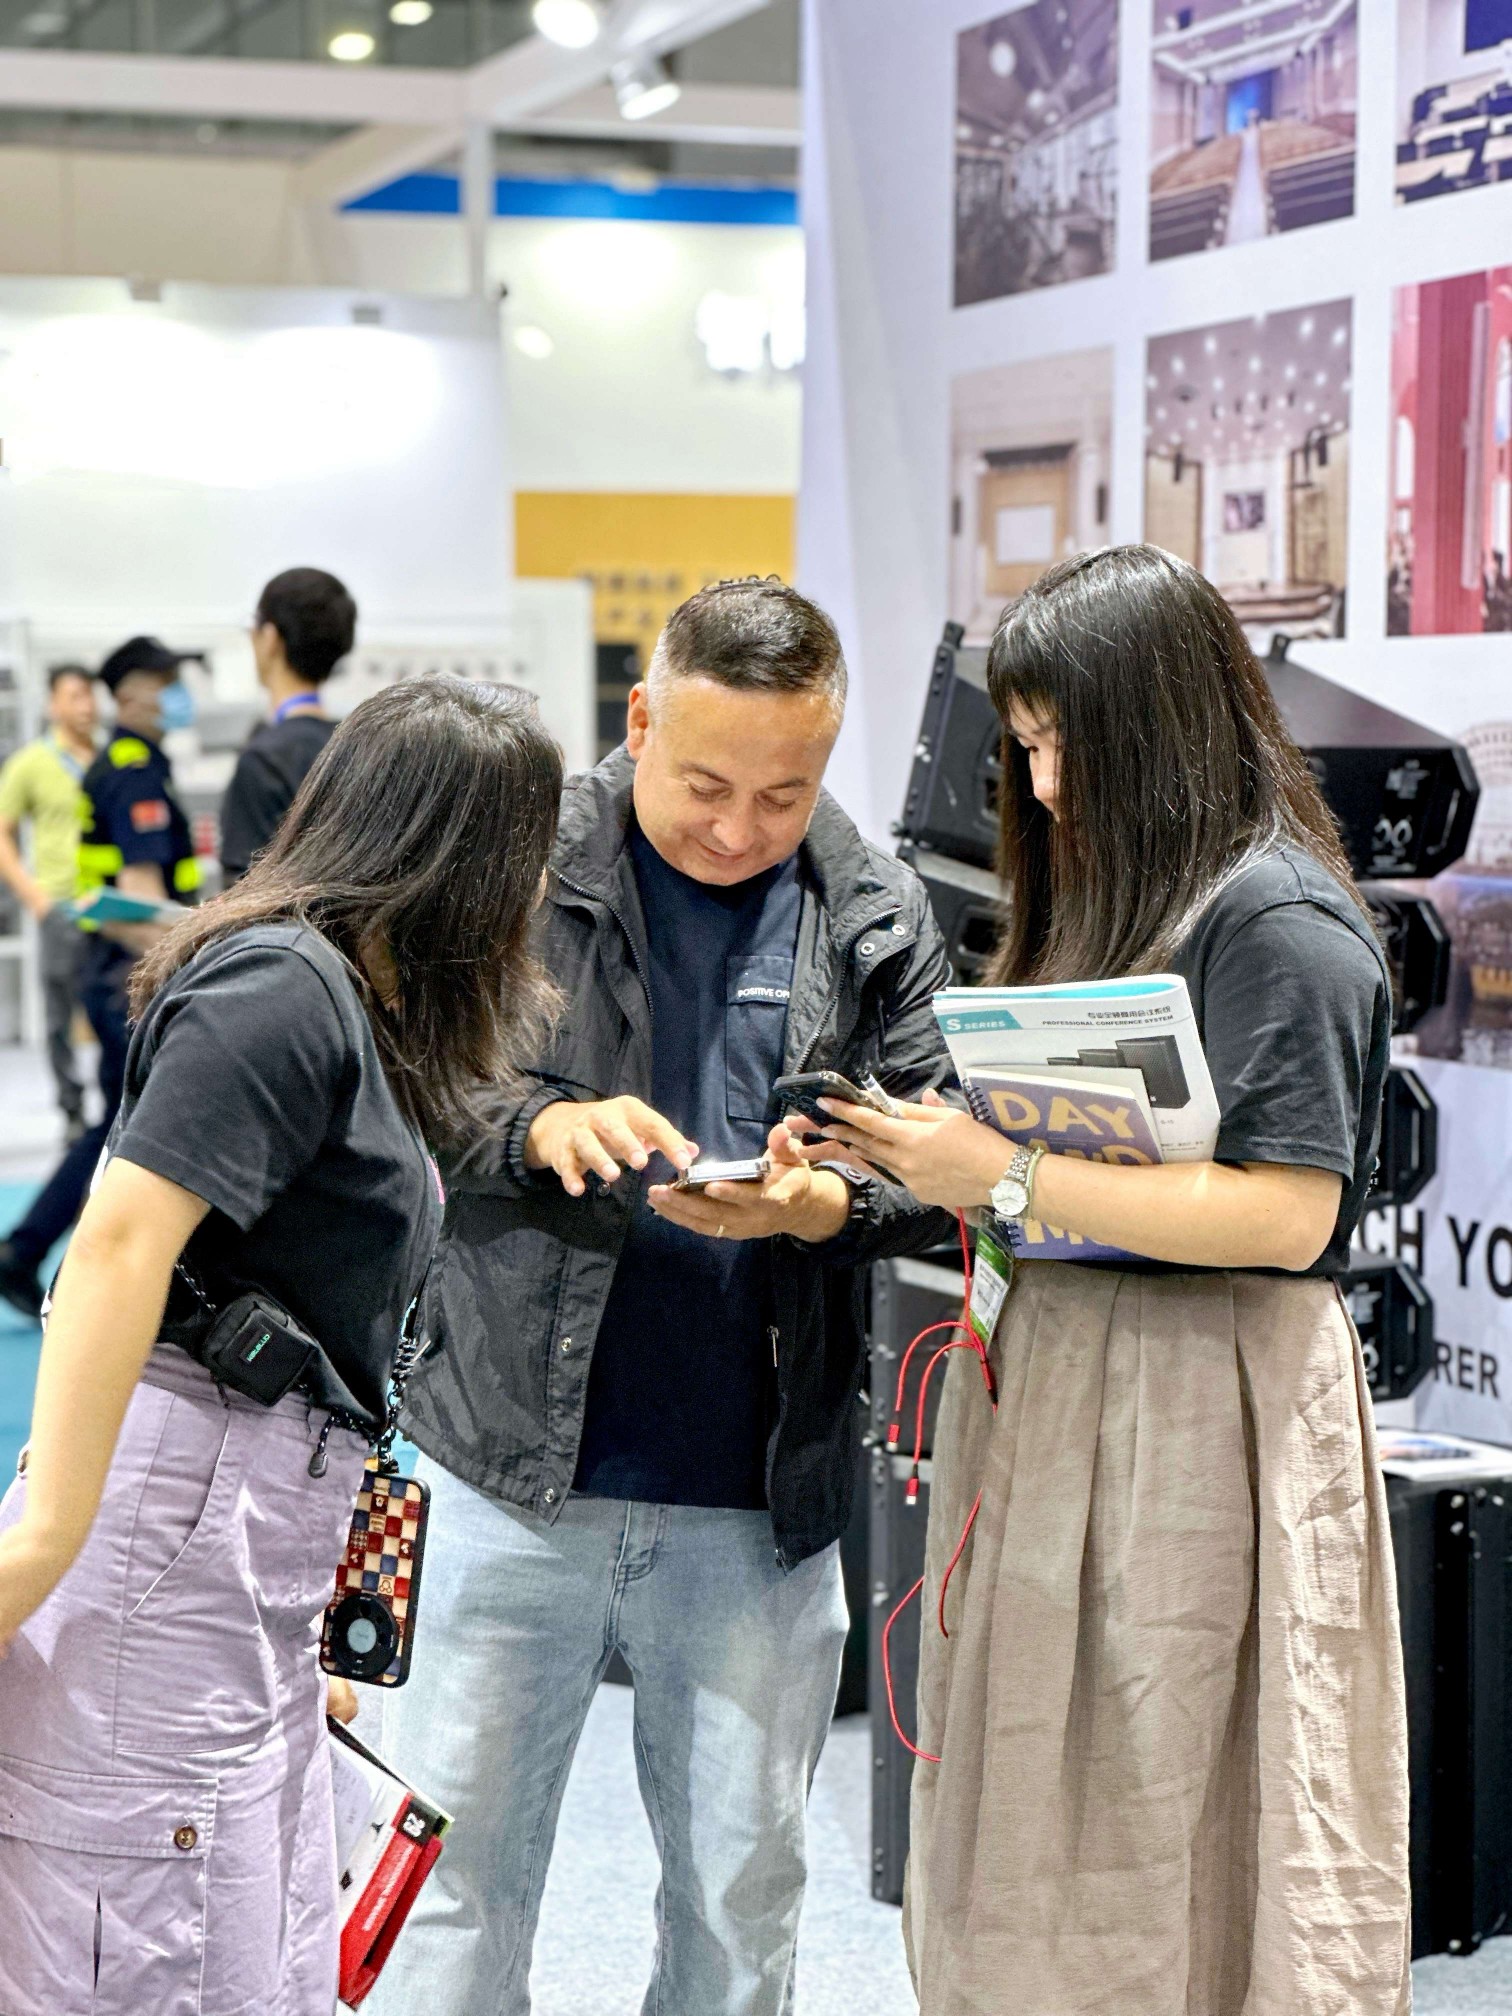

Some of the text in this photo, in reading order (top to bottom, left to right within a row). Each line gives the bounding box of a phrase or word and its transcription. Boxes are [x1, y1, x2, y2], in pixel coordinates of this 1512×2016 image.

[737, 987, 774, 998] POSITIVE
[946, 1018, 1006, 1031] S SERIES
[1095, 1018, 1143, 1026] CONFERENCE
[1144, 1014, 1174, 1024] SYSTEM
[989, 1090, 1135, 1139] DAY
